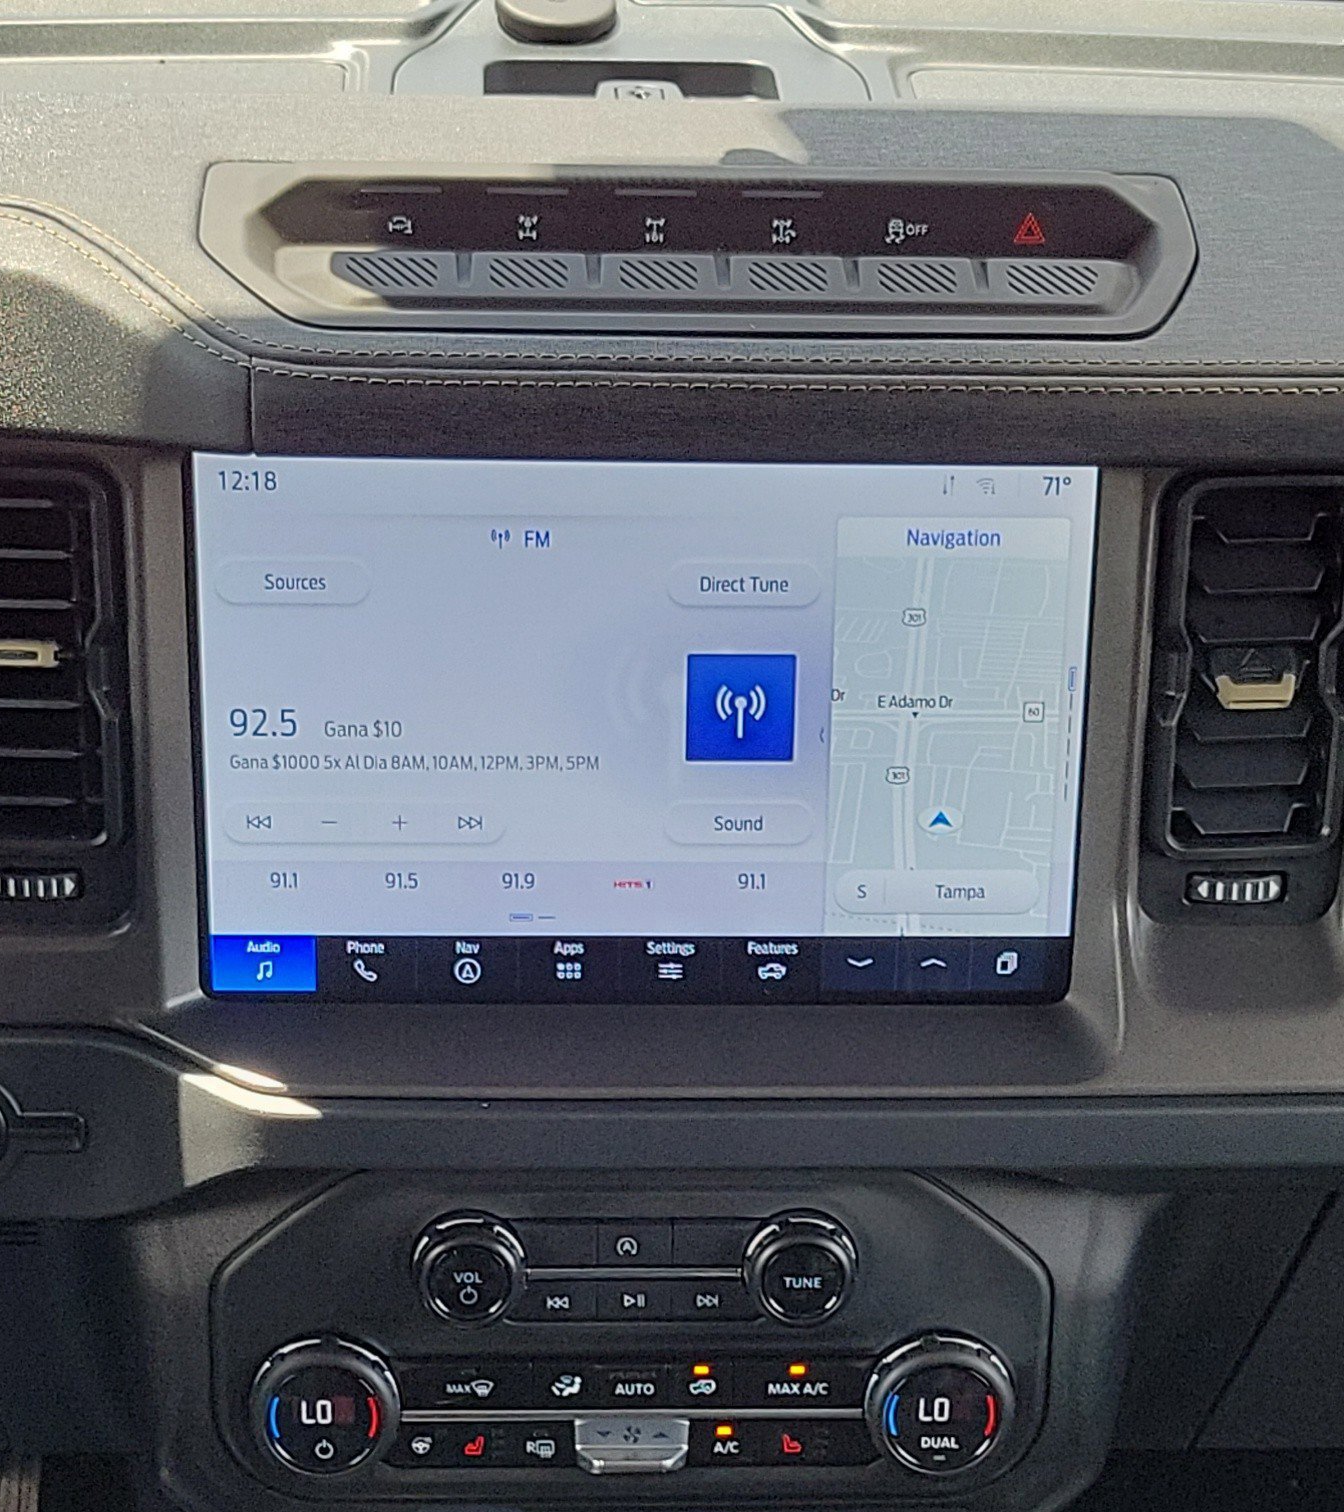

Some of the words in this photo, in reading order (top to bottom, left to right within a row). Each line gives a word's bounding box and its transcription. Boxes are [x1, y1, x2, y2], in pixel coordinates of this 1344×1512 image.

[905, 223, 929, 236] OFF
[218, 471, 277, 491] 12:18
[1043, 476, 1072, 496] 71°
[524, 530, 551, 549] FM
[906, 528, 1002, 550] Navigation
[264, 573, 327, 591] Sources
[700, 575, 745, 593] Direct
[751, 576, 789, 593] Tune
[878, 695, 886, 708] E
[889, 695, 936, 709] Adamo
[939, 695, 953, 708] Dr
[229, 708, 298, 737] 92.5
[324, 720, 369, 738] Gana
[373, 719, 402, 738] $10
[230, 754, 269, 770] Gana
[272, 753, 320, 771] $1000
[324, 755, 342, 770] 5x
[345, 755, 360, 770] Al
[391, 755, 429, 771] 8AM,
[432, 755, 477, 771] 10AM,
[481, 755, 523, 771] 12PM,
[526, 755, 563, 771] 3PM,
[566, 755, 599, 770] 5PM
[714, 815, 763, 832] Sound
[270, 872, 298, 889] 91.1
[385, 872, 418, 889] 91.5
[501, 872, 535, 890] 91.9
[738, 873, 766, 890] 91.1
[857, 885, 866, 898] S
[935, 884, 986, 902] Tampa
[247, 940, 281, 954] Audio
[346, 940, 384, 954] Phone
[456, 941, 479, 954] Nav
[554, 941, 584, 958] Apps
[646, 942, 695, 958] Settings
[747, 942, 799, 956] Features
[454, 1271, 483, 1284] VOL
[783, 1276, 823, 1290] TUNE
[446, 1383, 472, 1394] MAX
[614, 1382, 655, 1395] AUTO
[767, 1382, 800, 1395] MAX
[802, 1382, 830, 1396] A/C
[301, 1399, 333, 1425] LO
[918, 1397, 950, 1423] LO
[526, 1440, 536, 1453] R
[713, 1441, 740, 1455] A/C
[920, 1437, 960, 1450] DUAL
